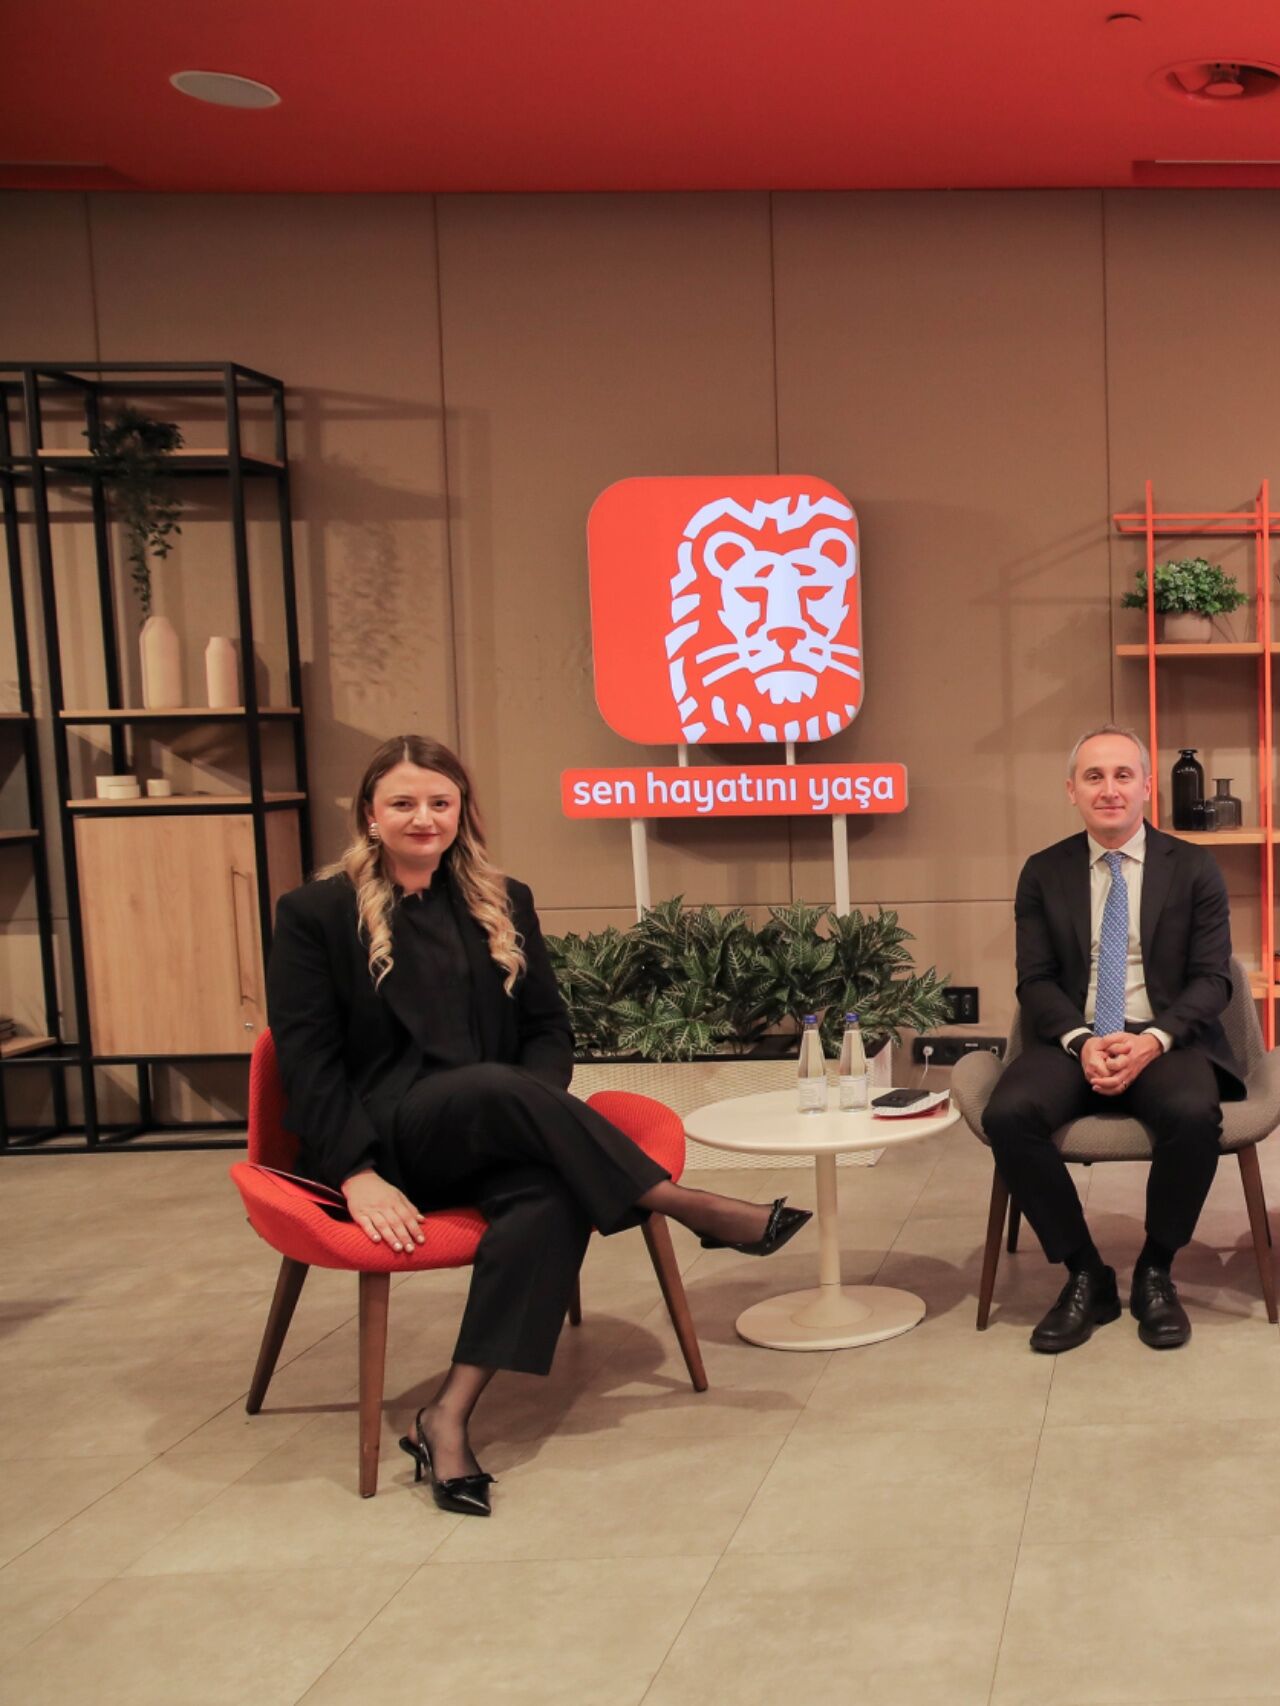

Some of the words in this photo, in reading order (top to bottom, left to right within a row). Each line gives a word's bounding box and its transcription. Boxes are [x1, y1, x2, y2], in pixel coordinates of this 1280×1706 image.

[573, 781, 636, 806] sen
[646, 771, 798, 812] hayatını
[808, 775, 894, 810] yaşa
